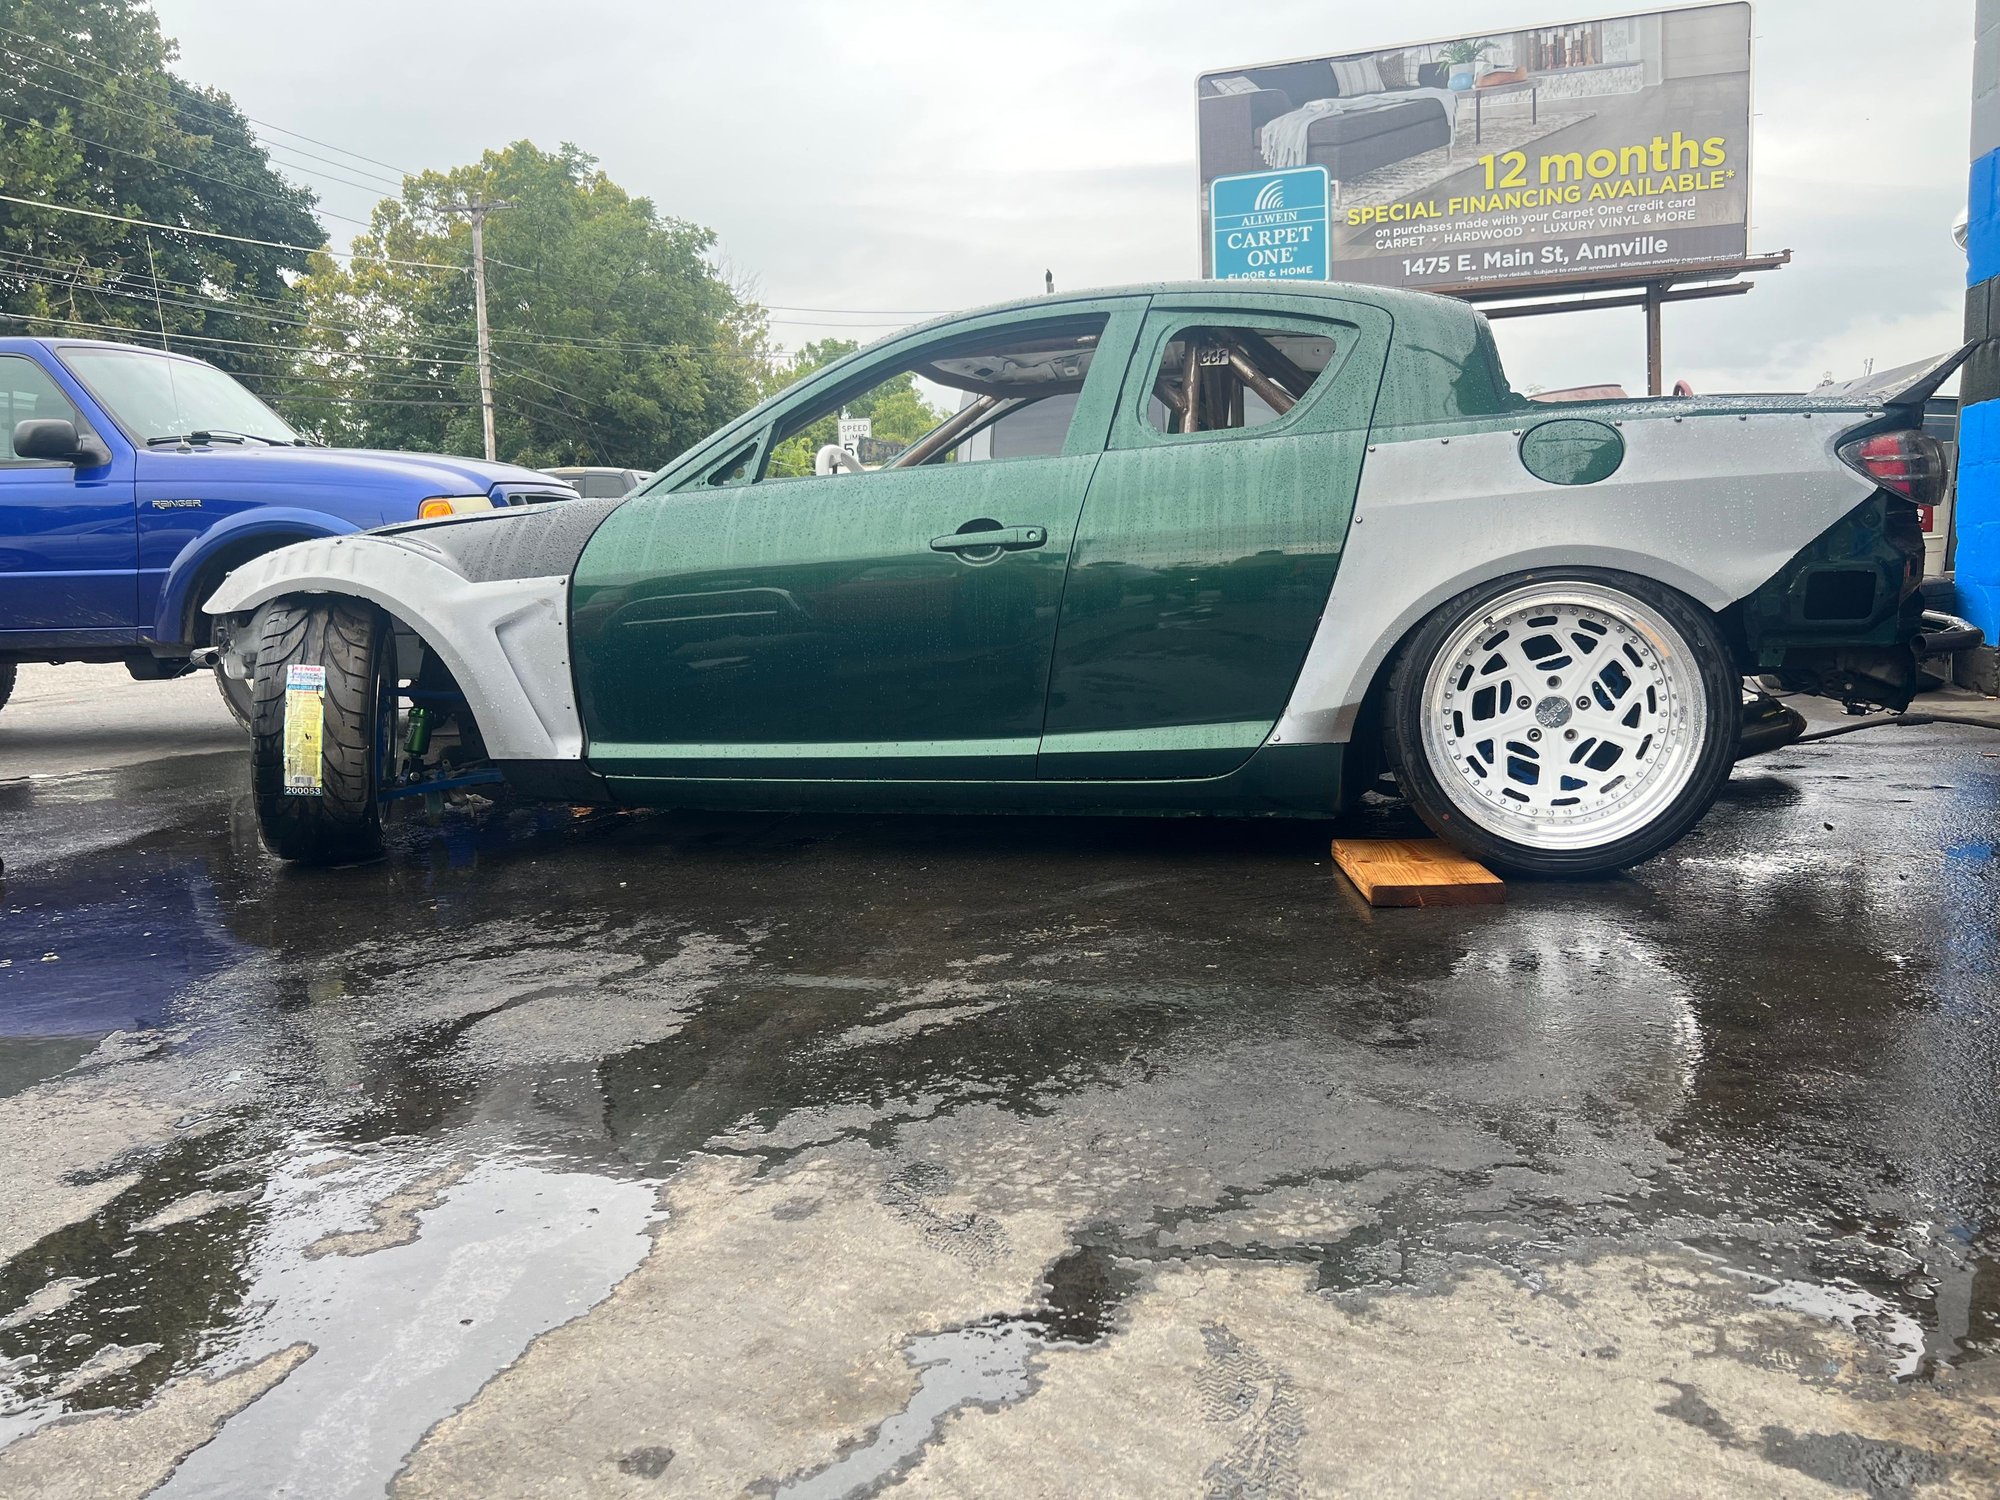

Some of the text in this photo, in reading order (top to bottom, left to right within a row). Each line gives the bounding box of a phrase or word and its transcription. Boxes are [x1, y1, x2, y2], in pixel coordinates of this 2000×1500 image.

[1478, 131, 1726, 190] 12 months
[1347, 201, 1442, 226] SPECIAL
[1448, 185, 1581, 215] FINANCING
[1375, 196, 1696, 238] on purchases made with your Carpet One credit card
[1241, 210, 1298, 227] ALLWEIN
[1375, 209, 1696, 250] CARPET HARDWOOD LUXURY VINYL & MORE
[1227, 226, 1313, 249] CARPET
[1402, 236, 1668, 276] 1475 E. Main St, Annville
[1268, 268, 1277, 278] &
[1280, 265, 1313, 276] HOME
[841, 424, 868, 432] SPEED
[151, 499, 202, 510] RANGER
[285, 786, 321, 795] 200053
